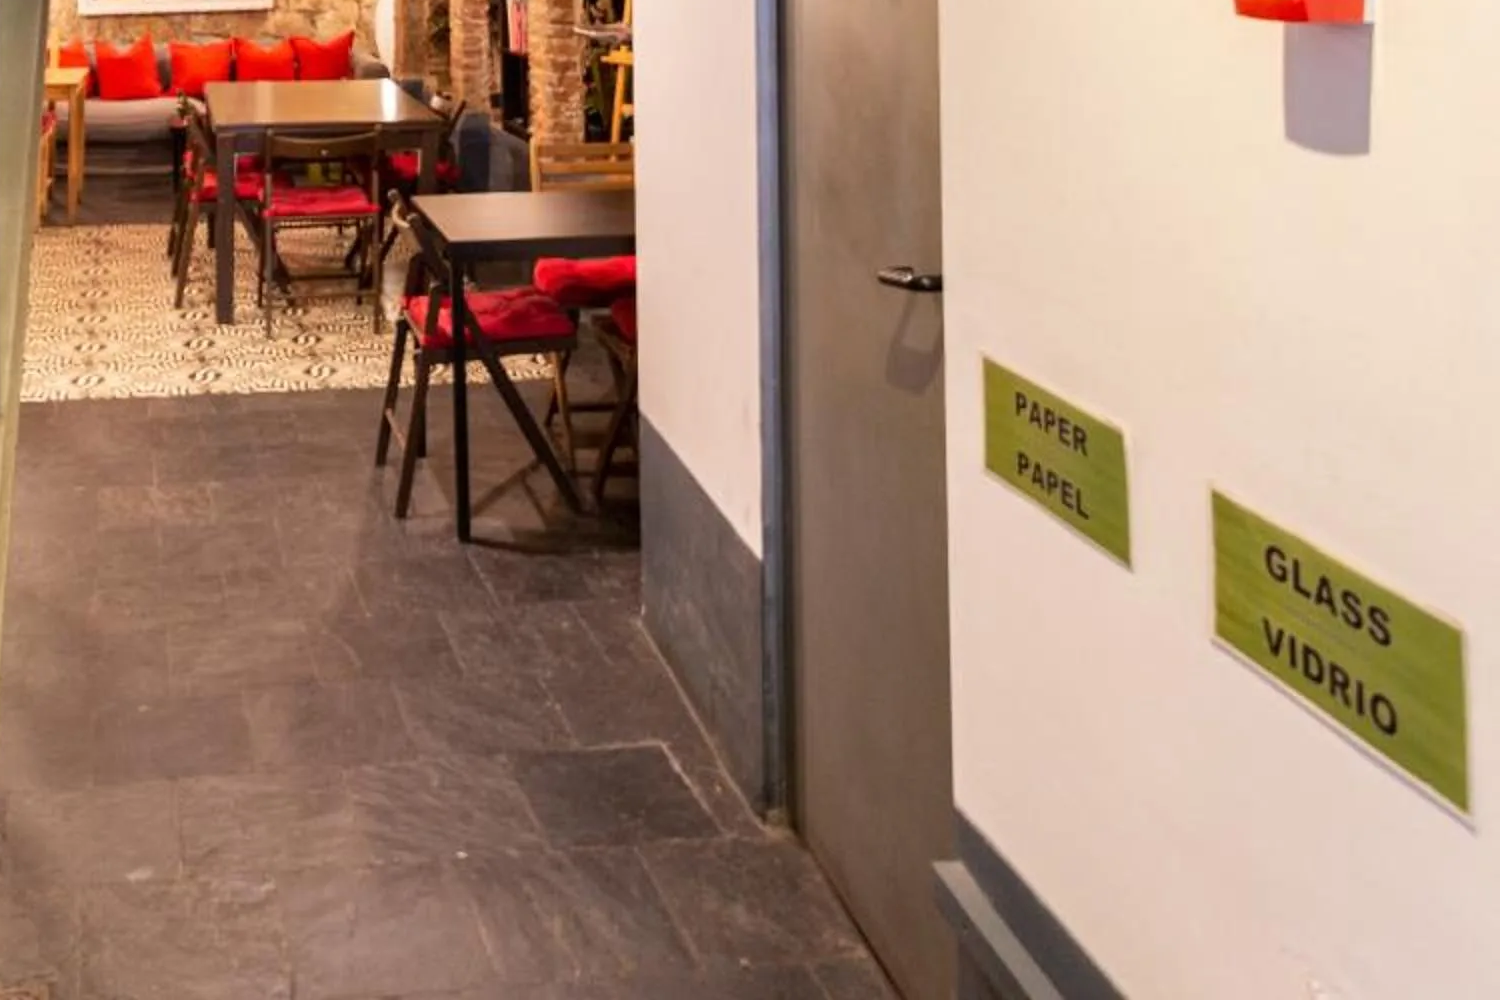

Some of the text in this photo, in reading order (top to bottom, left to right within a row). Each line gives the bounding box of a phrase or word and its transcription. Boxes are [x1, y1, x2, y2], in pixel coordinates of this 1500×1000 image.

[1015, 391, 1088, 456] PAPER
[1016, 451, 1089, 520] PAPEL
[1264, 544, 1393, 647] GLASS
[1262, 617, 1398, 736] VIDRIO
